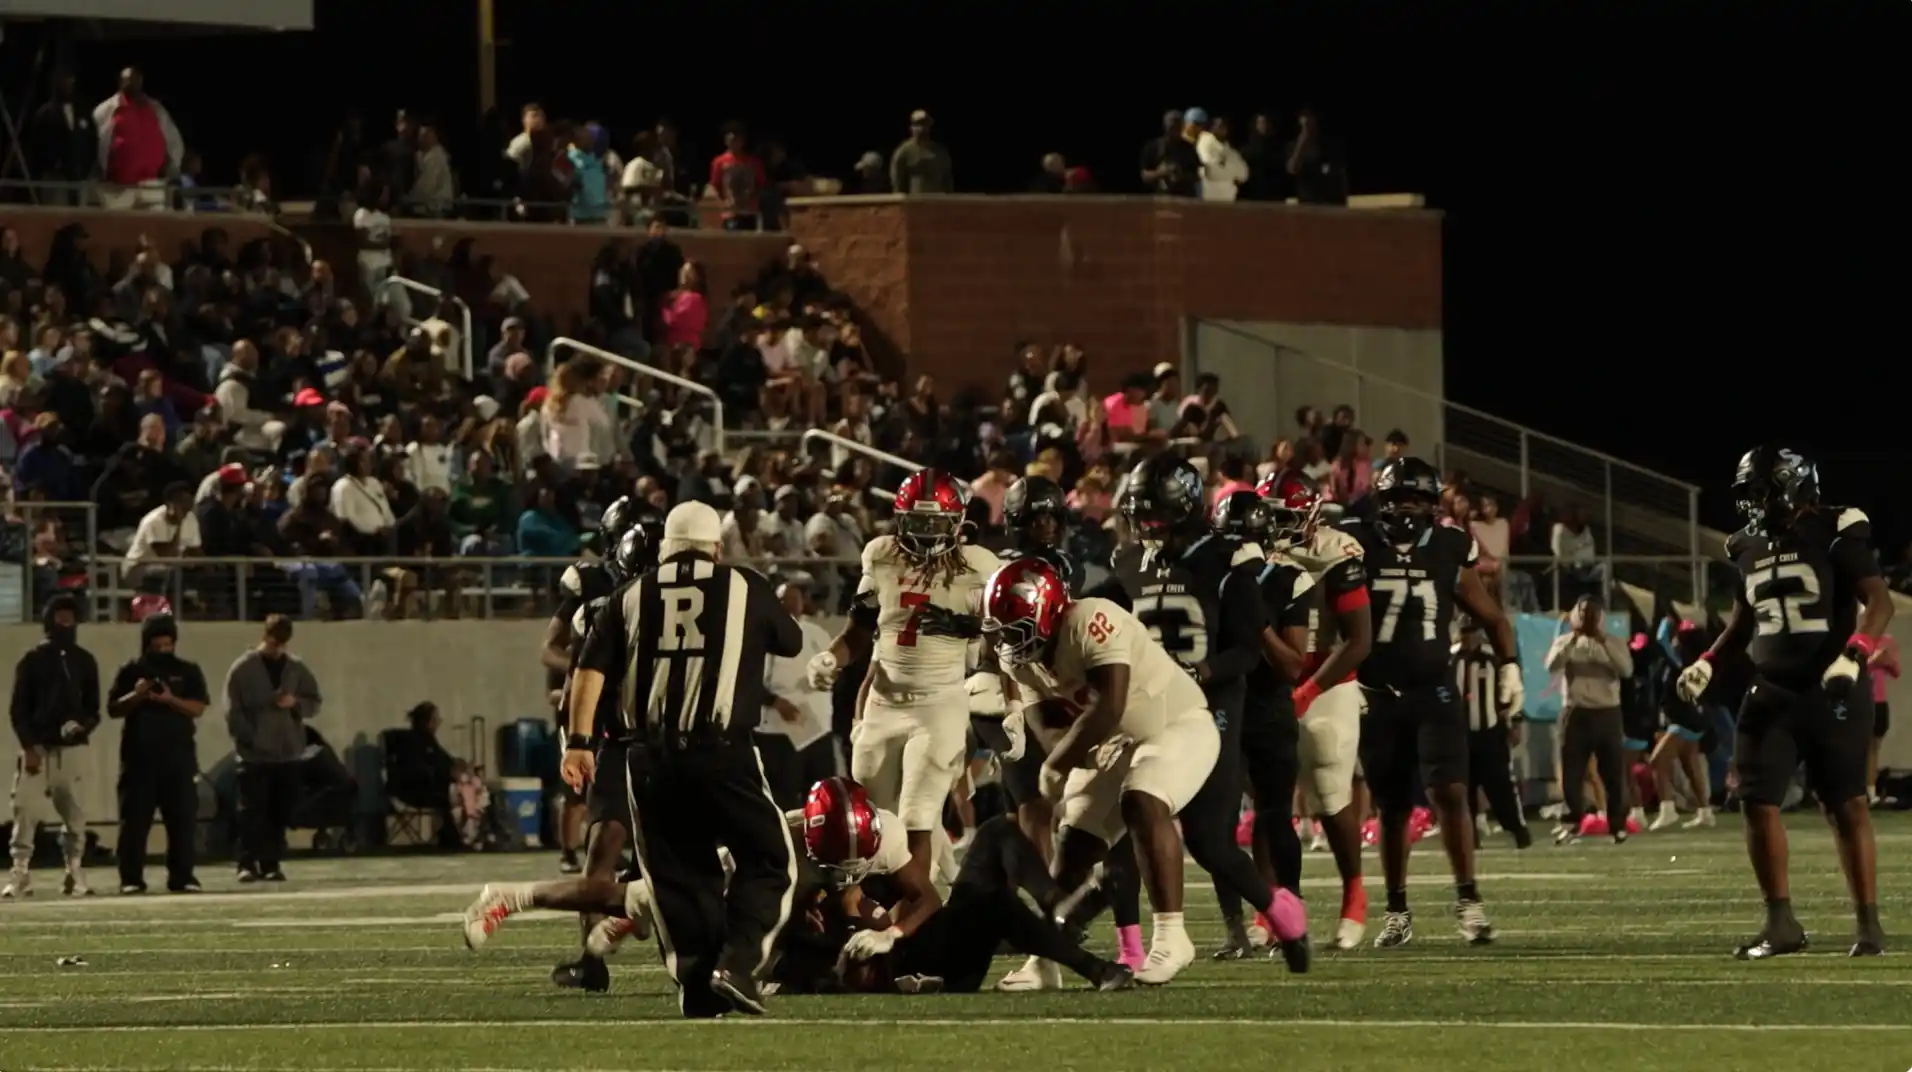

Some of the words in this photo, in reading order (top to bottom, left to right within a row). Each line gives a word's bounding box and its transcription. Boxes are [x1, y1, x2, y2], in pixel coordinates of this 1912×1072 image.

[657, 585, 706, 650] R
[897, 591, 930, 647] 7
[1088, 611, 1115, 644] 92
[1371, 578, 1438, 643] 71
[1745, 562, 1830, 636] 52
